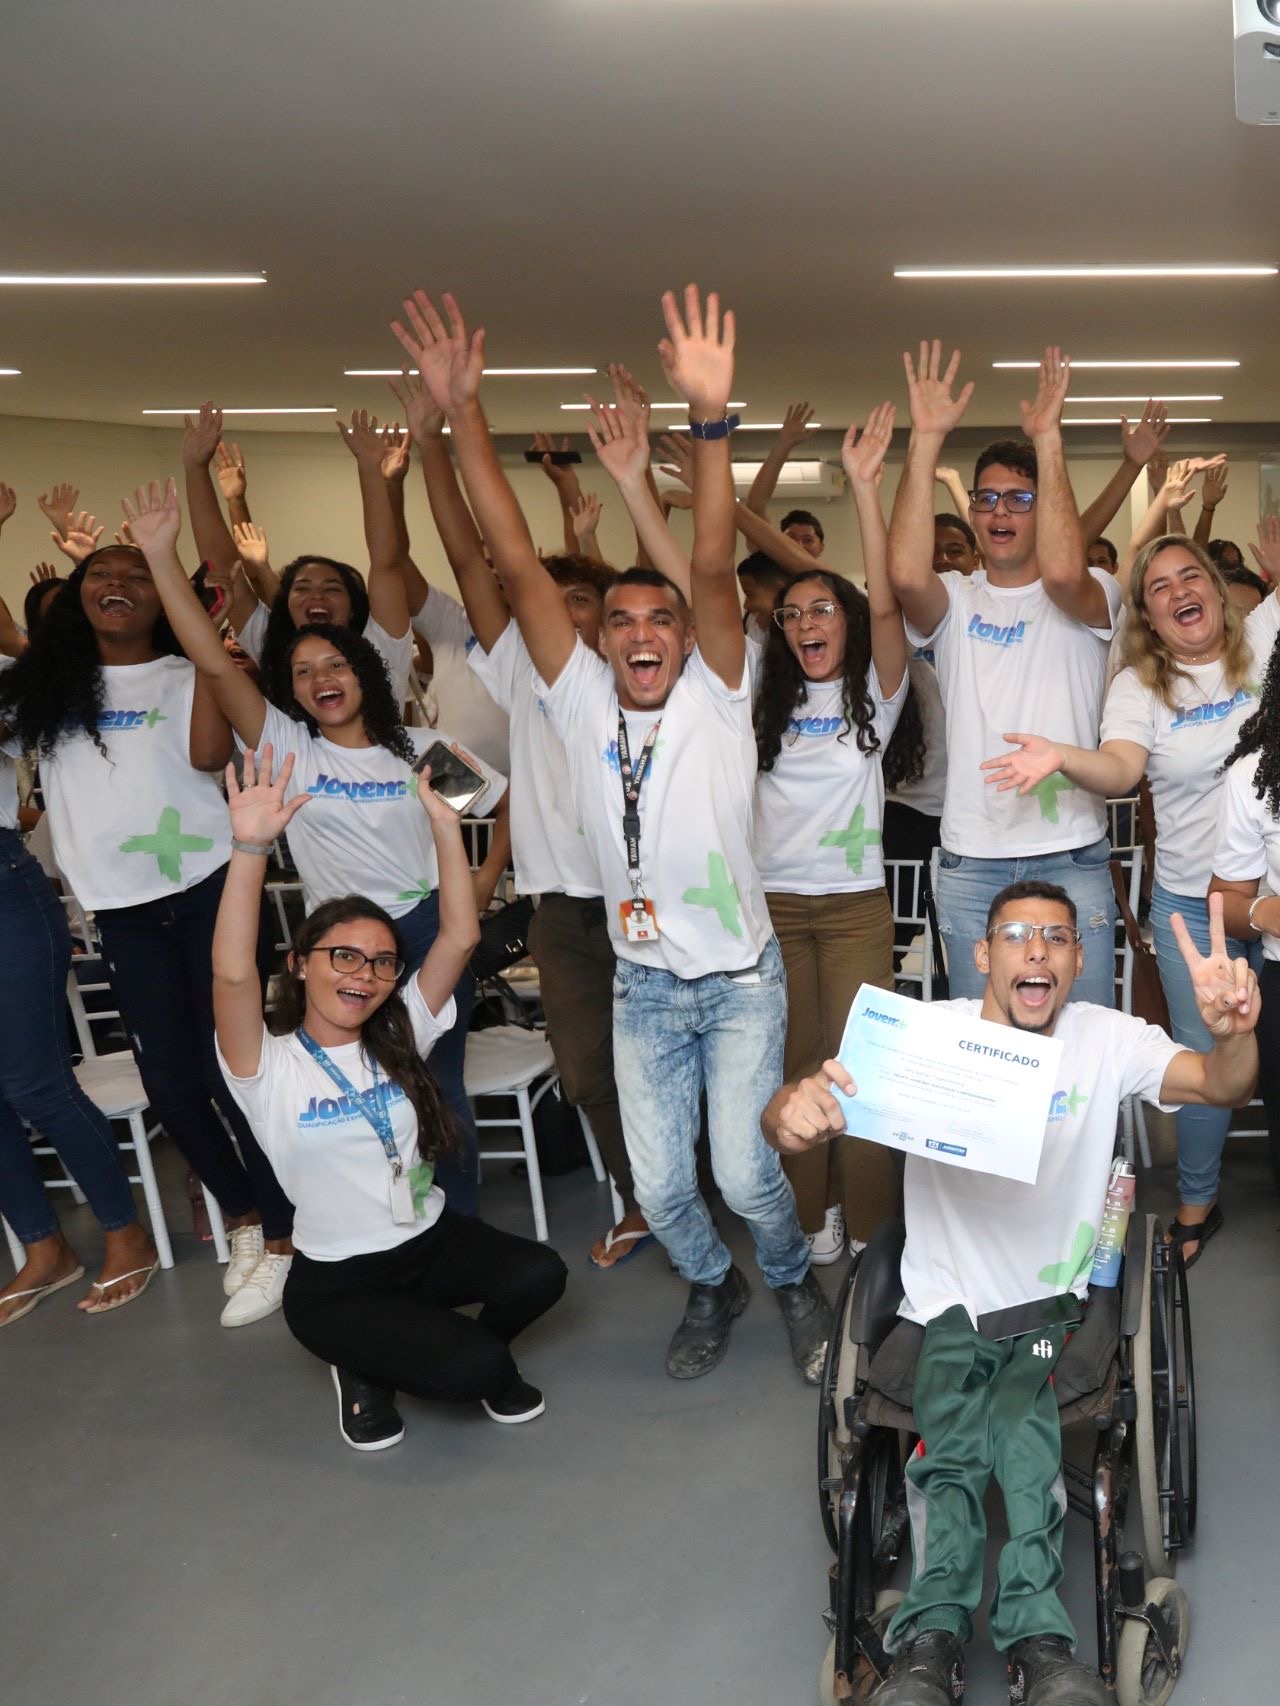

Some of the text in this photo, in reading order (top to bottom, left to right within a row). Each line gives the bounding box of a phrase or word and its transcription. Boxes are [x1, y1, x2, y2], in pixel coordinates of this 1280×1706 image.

[618, 729, 629, 759] YAMAHA
[632, 754, 649, 785] YAMAHA
[958, 1040, 1040, 1069] CERTIFICADO
